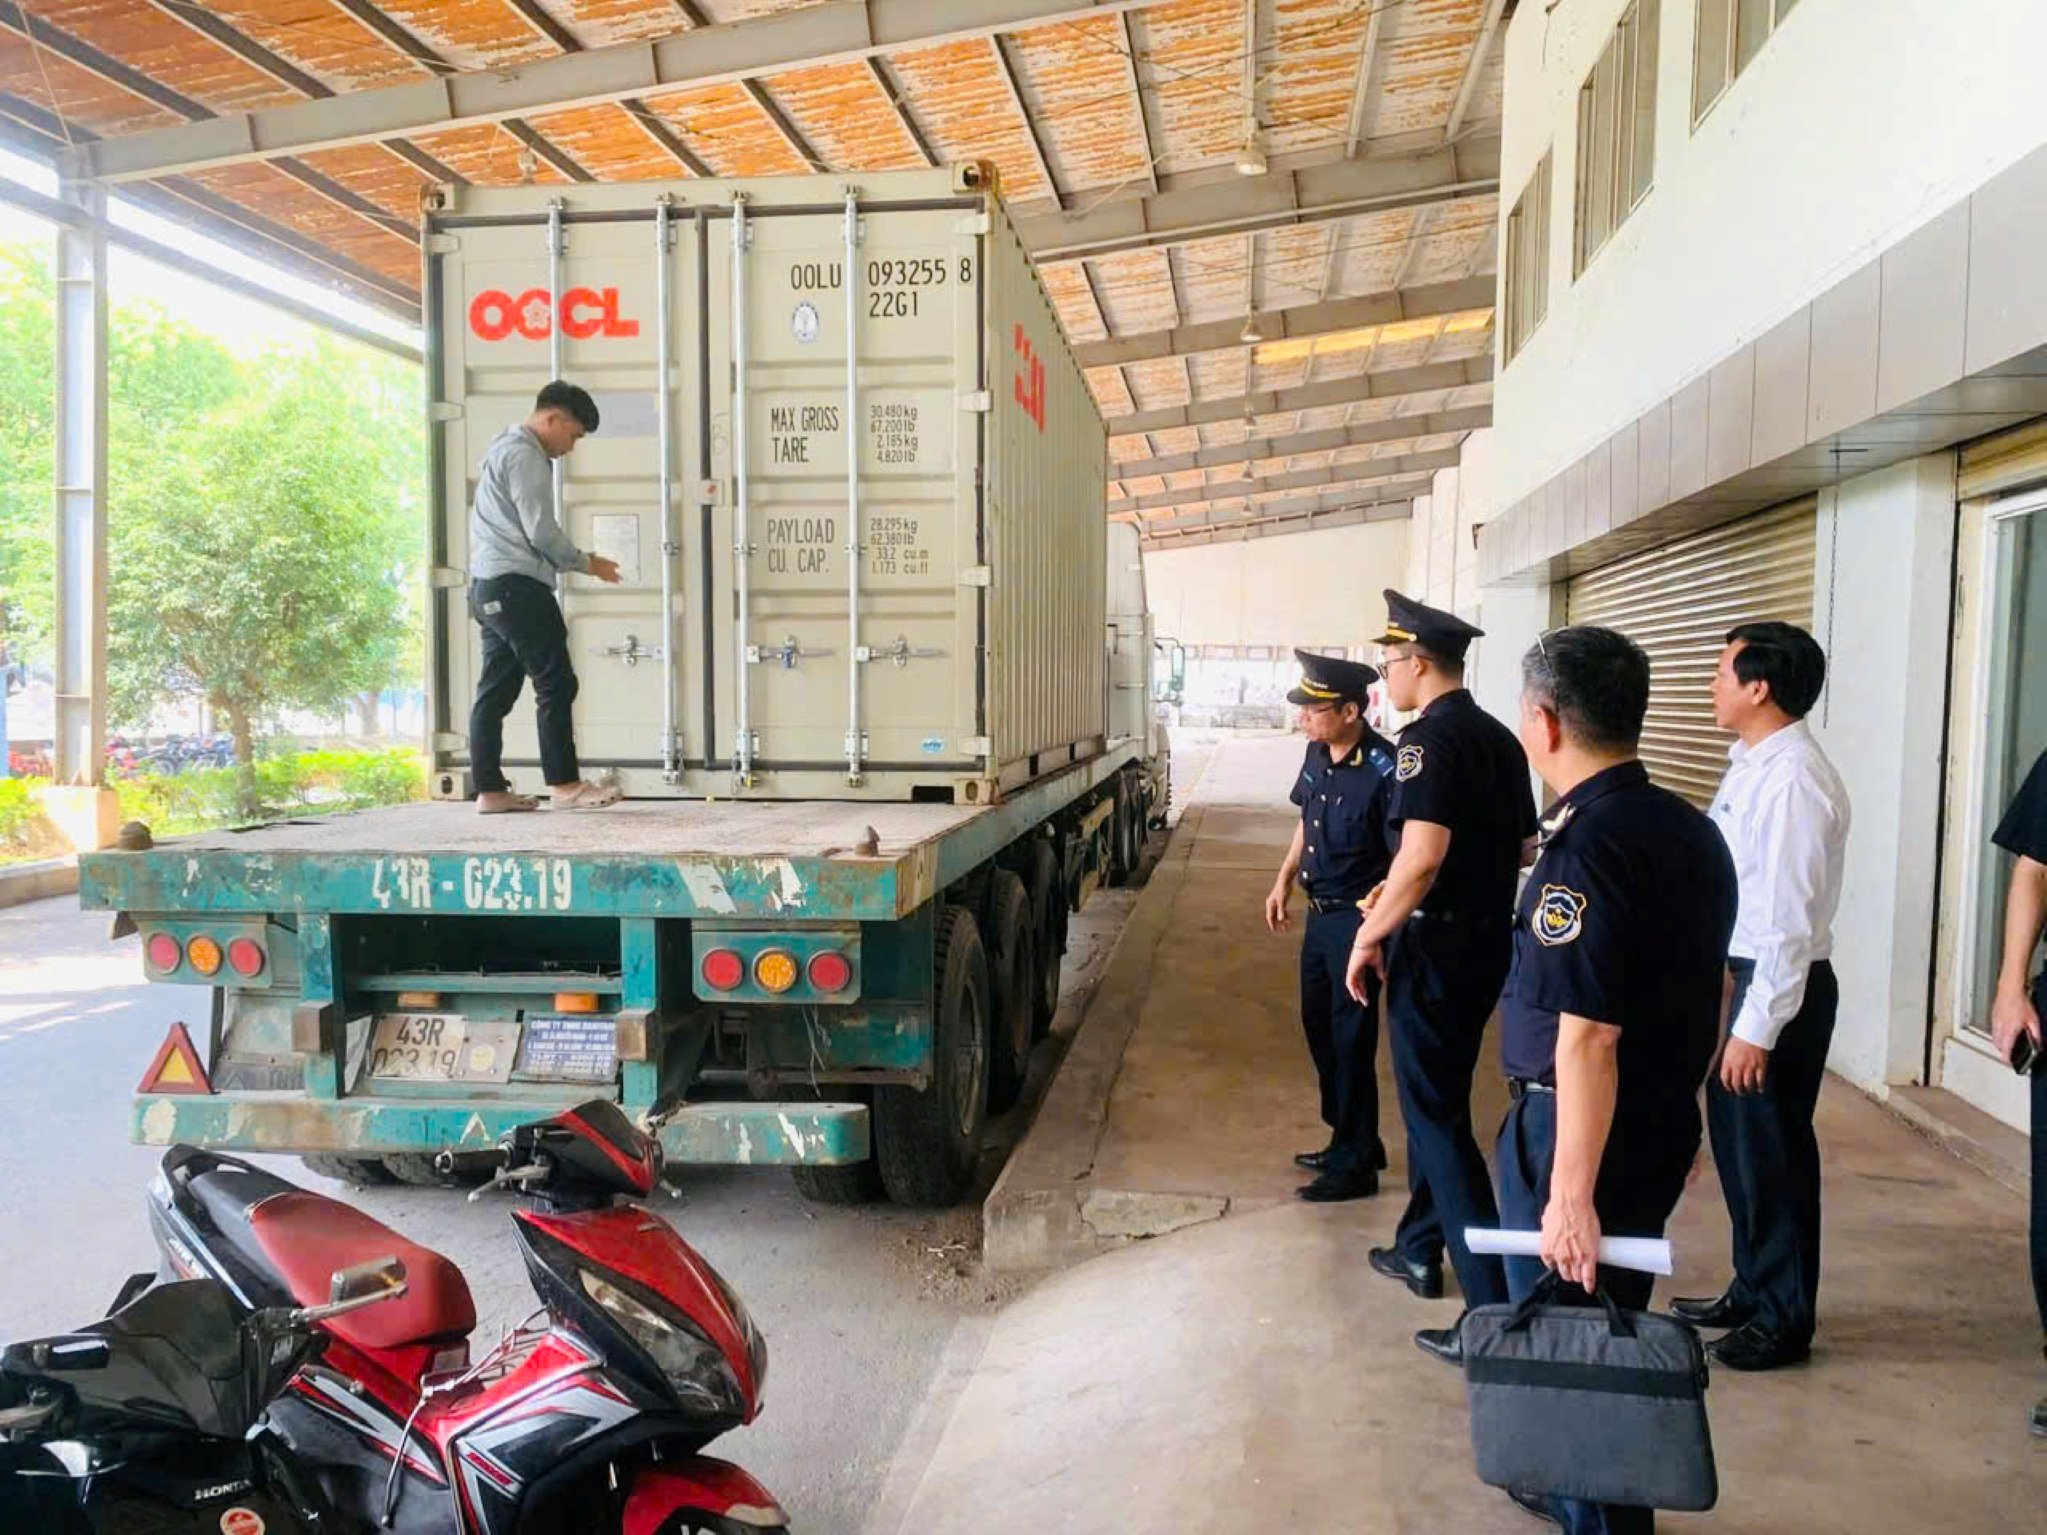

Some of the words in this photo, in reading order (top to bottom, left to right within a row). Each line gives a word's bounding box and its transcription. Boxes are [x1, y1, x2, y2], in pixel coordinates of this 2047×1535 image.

[791, 263, 842, 289] OOLU
[868, 258, 947, 286] 093255
[960, 258, 972, 283] 8
[469, 287, 639, 341] OOCL
[869, 291, 919, 317] 22G1
[771, 408, 796, 432] MAX
[801, 406, 839, 432] GROSS
[904, 405, 918, 420] kg
[904, 419, 915, 432] lb
[771, 436, 809, 463] TARE
[904, 434, 918, 451] kg
[904, 450, 915, 463] lb
[767, 518, 835, 544] PAYLOAD
[904, 517, 918, 534] kg
[904, 533, 915, 545] lb
[768, 548, 789, 573] CU.
[797, 548, 829, 573] CAP.
[395, 1017, 445, 1046] 43R
